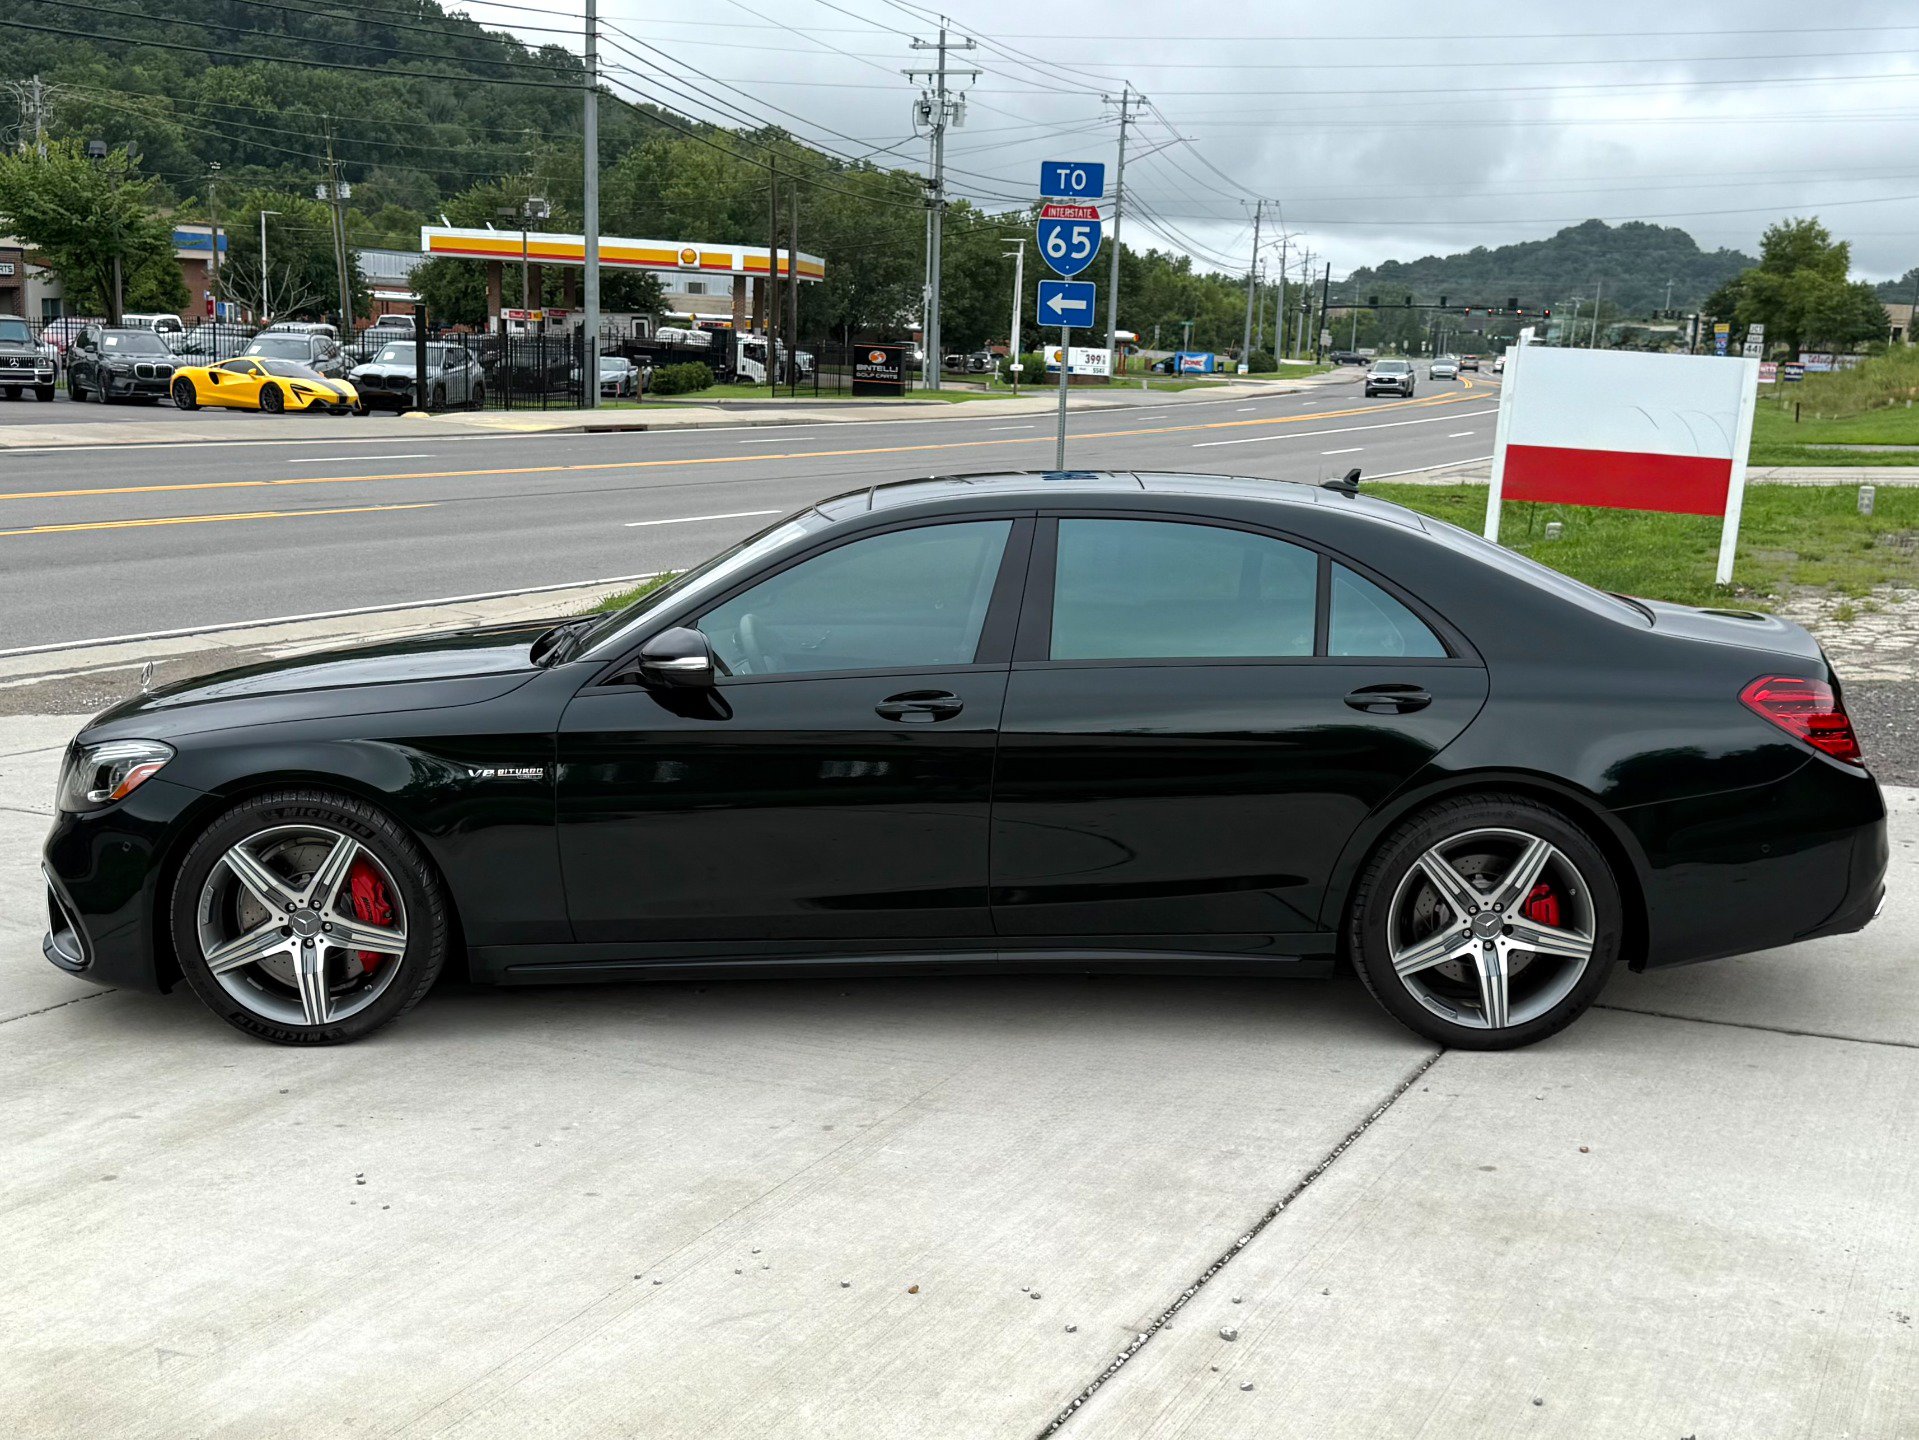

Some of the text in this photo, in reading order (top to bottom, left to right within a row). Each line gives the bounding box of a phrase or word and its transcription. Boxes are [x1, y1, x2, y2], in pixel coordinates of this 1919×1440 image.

[1057, 169, 1086, 190] TO
[1048, 207, 1092, 219] INTERSTATE
[1047, 225, 1091, 259] 65
[1745, 345, 1762, 354] 441
[1085, 353, 1101, 365] 399
[468, 767, 544, 777] V8 BITURBO
[283, 807, 369, 838] MICHELIN
[236, 1014, 321, 1042] MICHELIN
